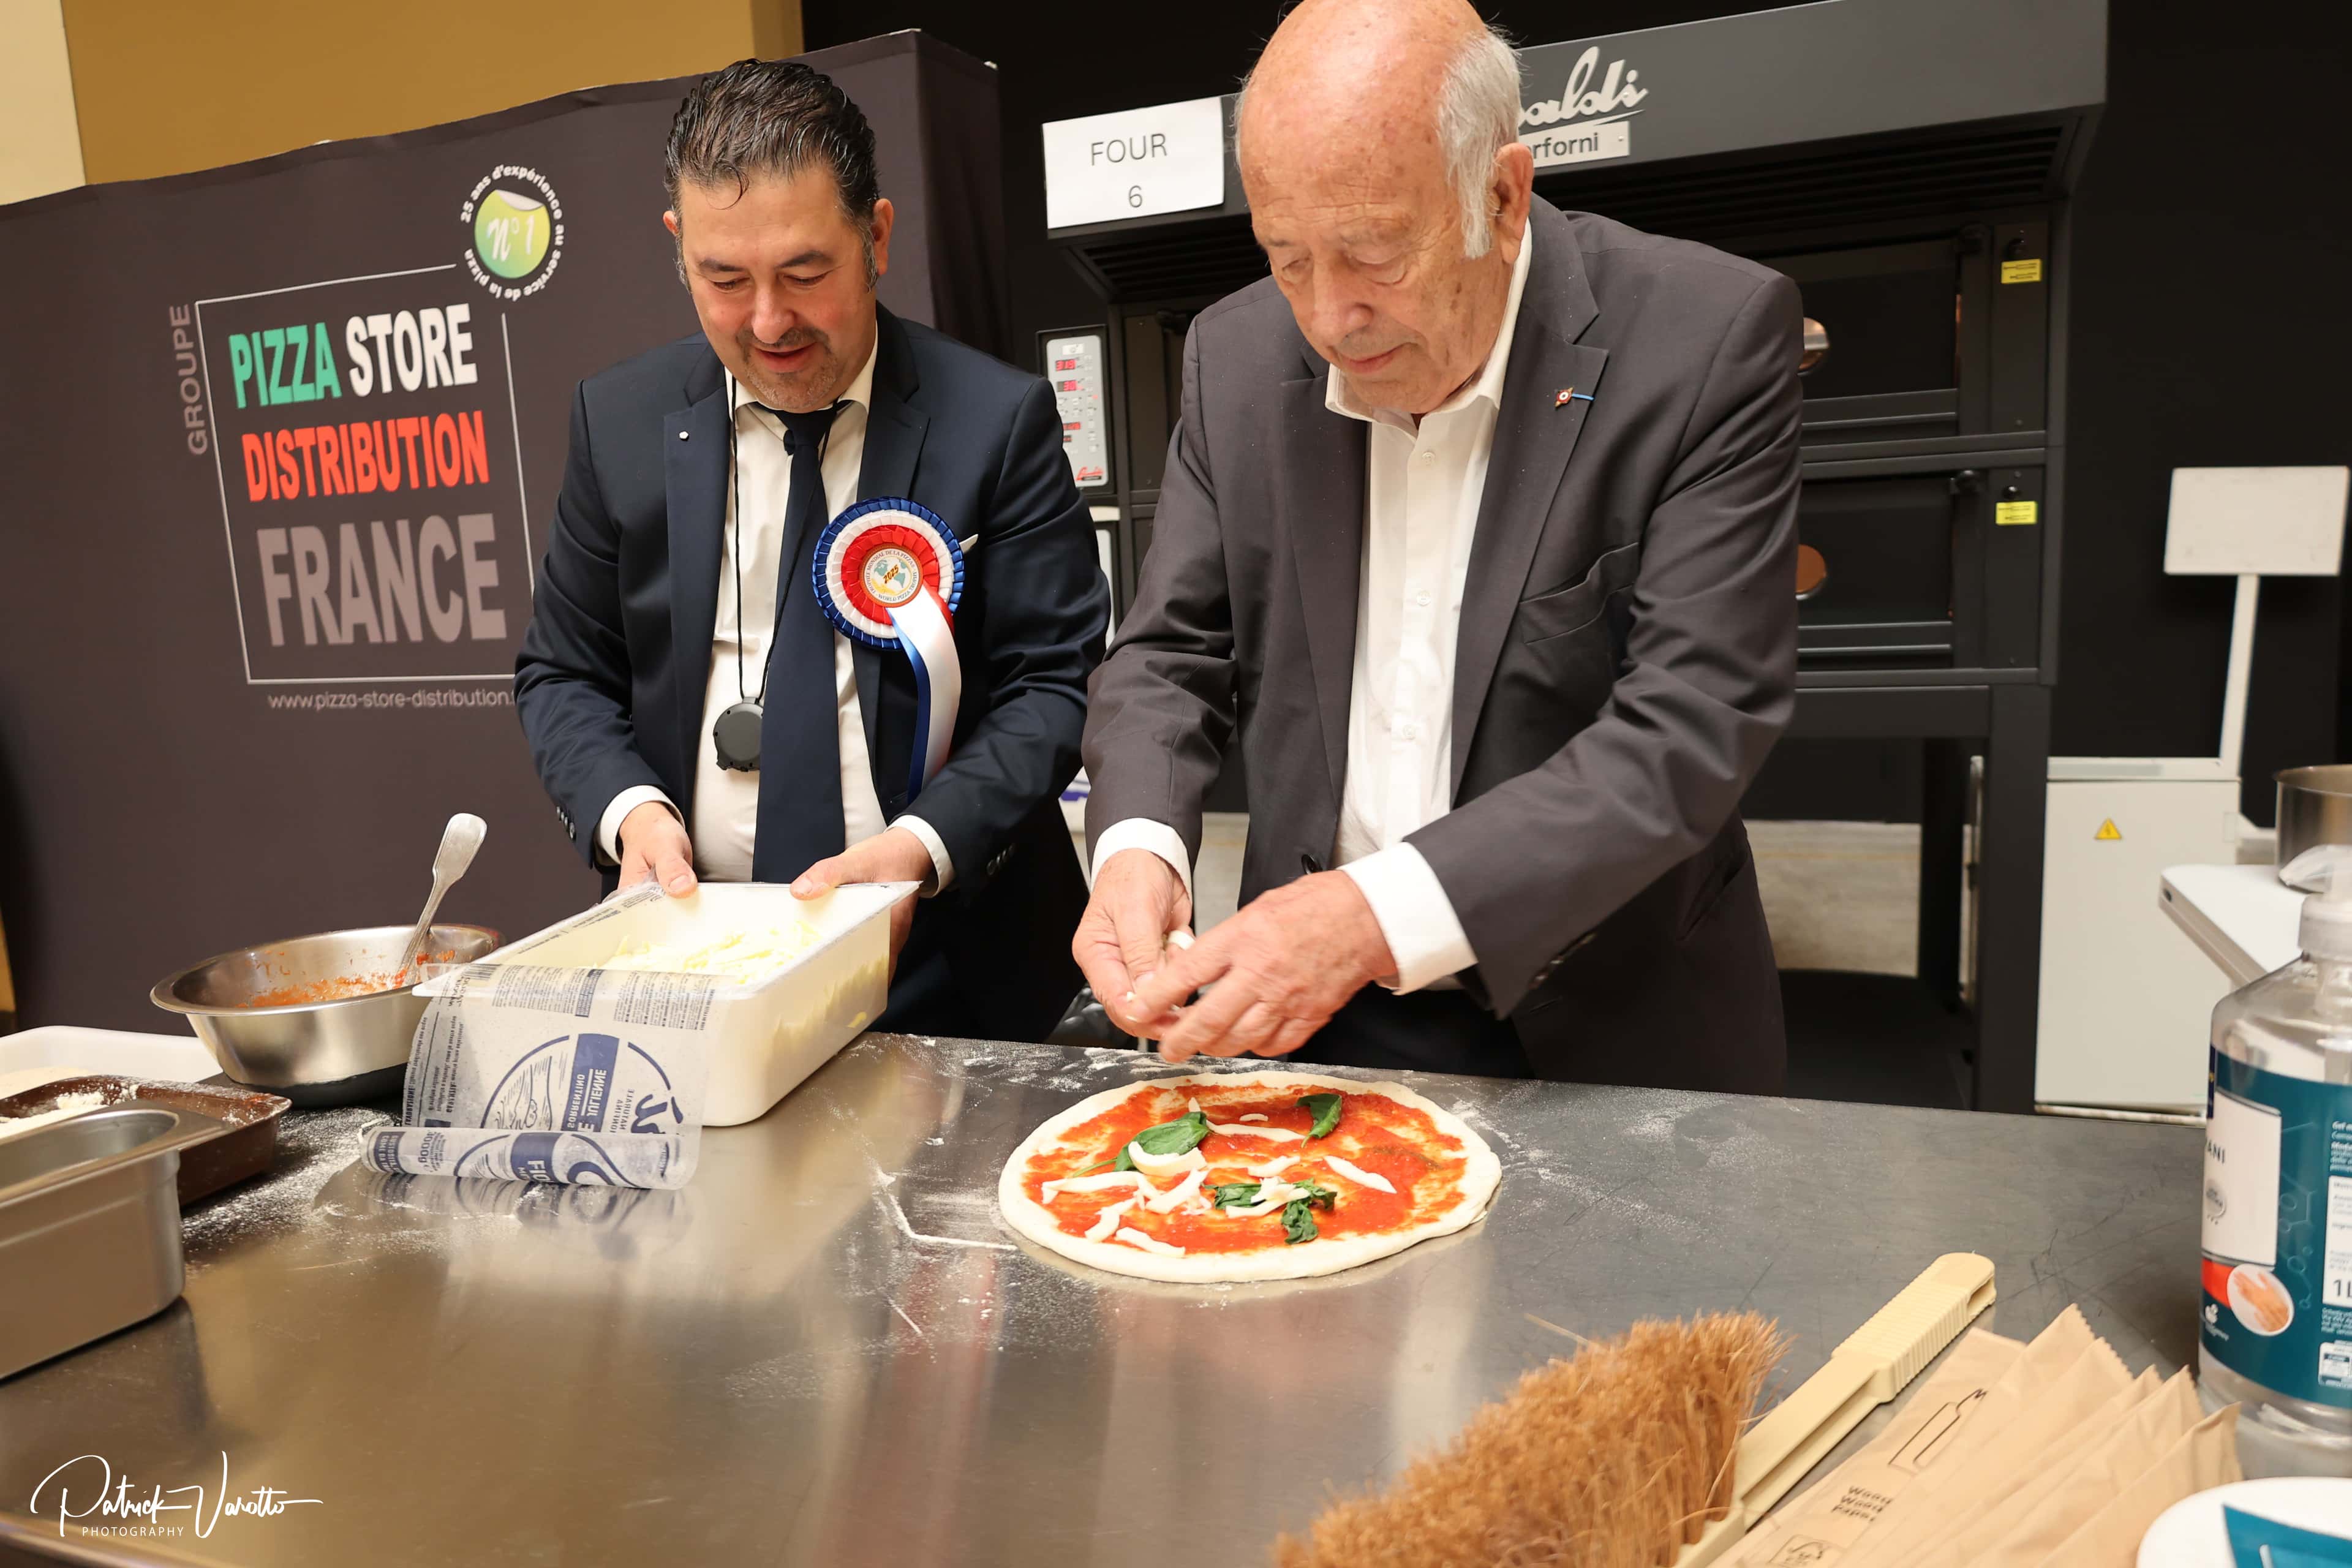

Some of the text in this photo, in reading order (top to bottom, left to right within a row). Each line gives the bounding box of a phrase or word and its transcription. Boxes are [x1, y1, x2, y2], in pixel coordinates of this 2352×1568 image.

[1519, 46, 1648, 126] aldi
[1090, 132, 1169, 167] FOUR
[1128, 184, 1144, 208] 6
[461, 164, 564, 301] 25 ans d'expérience au service de la pizza
[169, 304, 208, 455] GROUPE
[228, 303, 478, 409] PIZZA STORE
[241, 410, 490, 502] DISTRIBUTION
[257, 513, 507, 647] FRANCE
[867, 552, 885, 570] MONDIAL
[883, 564, 899, 584] 2025
[897, 590, 910, 599] PIZZA
[268, 688, 515, 711] www.pizza-store-distribution.
